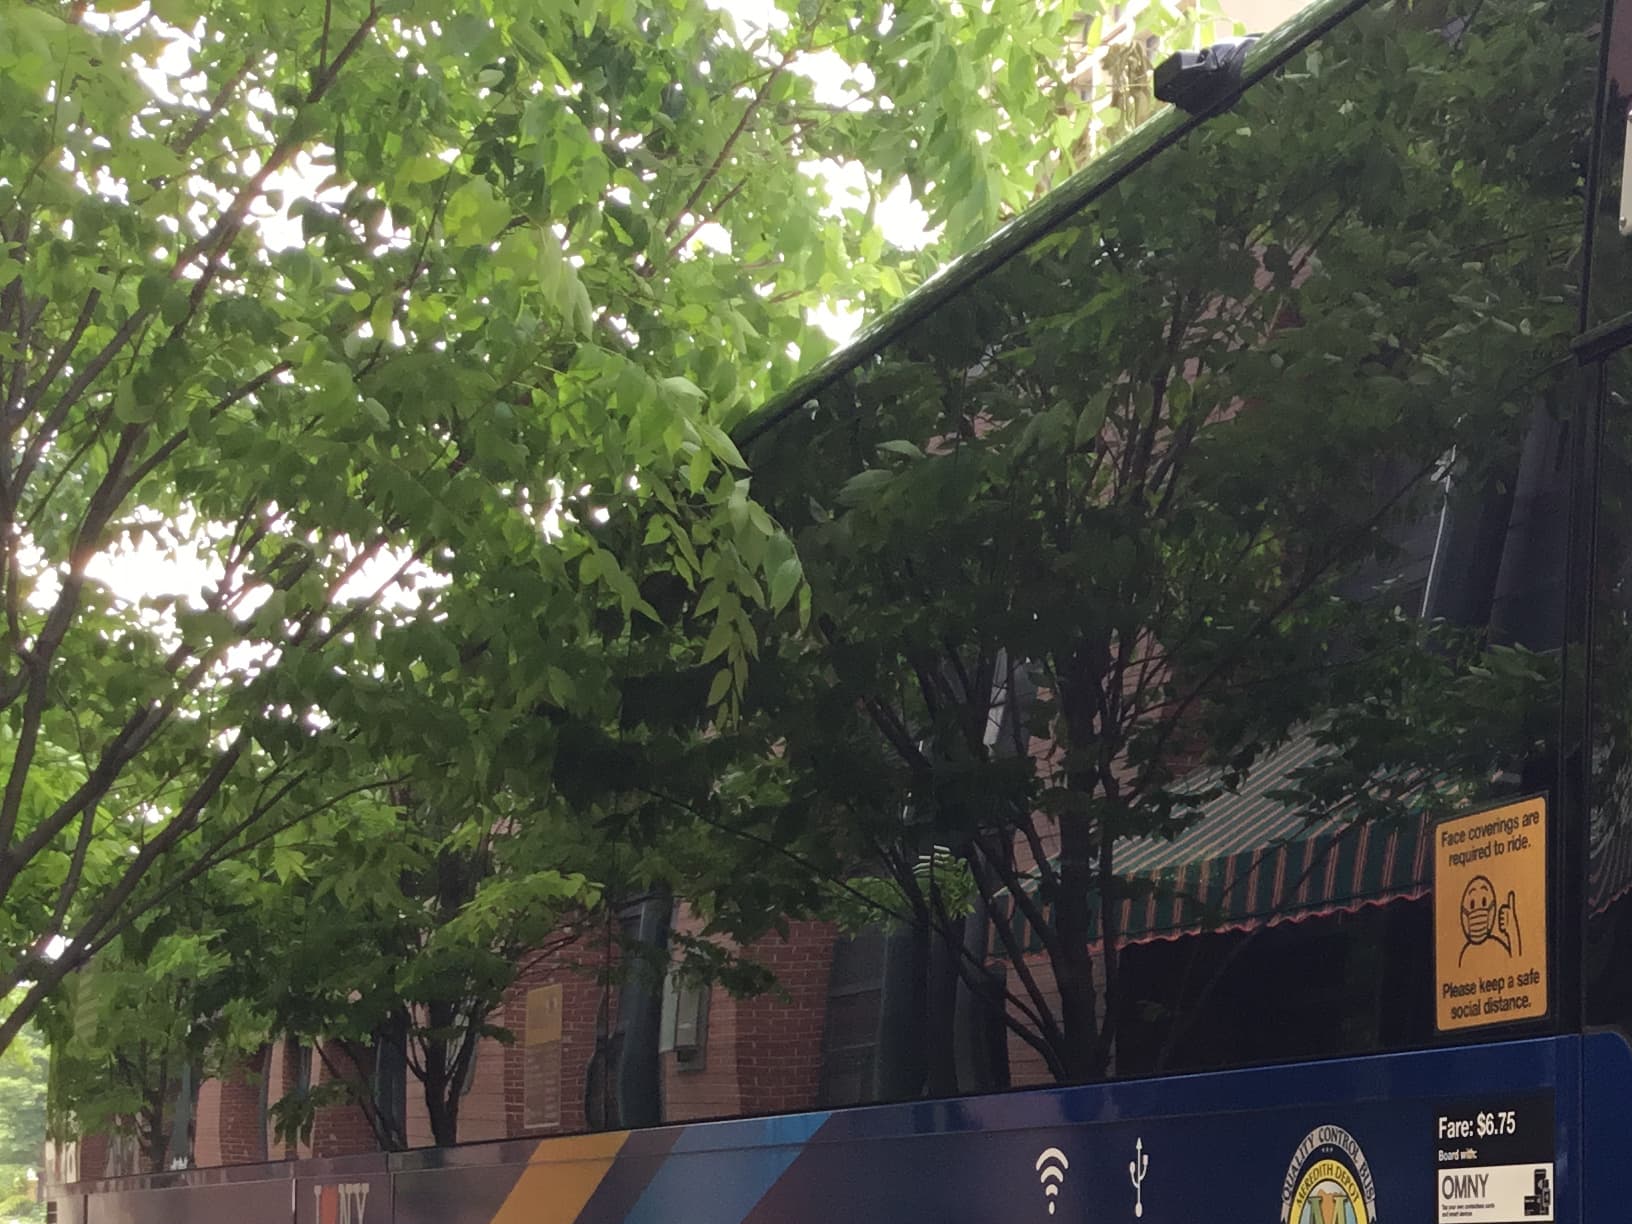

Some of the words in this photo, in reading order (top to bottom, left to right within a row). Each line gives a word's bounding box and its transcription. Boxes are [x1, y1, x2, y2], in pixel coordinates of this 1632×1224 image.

[1441, 830, 1466, 847] Face
[1468, 816, 1519, 835] coverings
[1522, 811, 1540, 828] are
[1448, 841, 1491, 867] required
[1494, 840, 1505, 856] to
[1507, 834, 1532, 853] ride.
[1443, 982, 1477, 999] Please
[1479, 976, 1505, 994] keep
[1507, 976, 1515, 989] a
[1516, 968, 1540, 987] safe
[1451, 999, 1481, 1020] social
[1483, 995, 1532, 1015] distance.
[1438, 1117, 1474, 1139] Fare:
[1476, 1111, 1516, 1139] $6.75
[1281, 1133, 1315, 1203] QUALITY
[1318, 1126, 1360, 1163] CONTROL
[1359, 1161, 1375, 1203] BUS
[1438, 1150, 1459, 1162] Board
[1296, 1163, 1334, 1207] MEREDITH
[1336, 1164, 1360, 1203] DEPOT
[1442, 1173, 1489, 1200] OMNY
